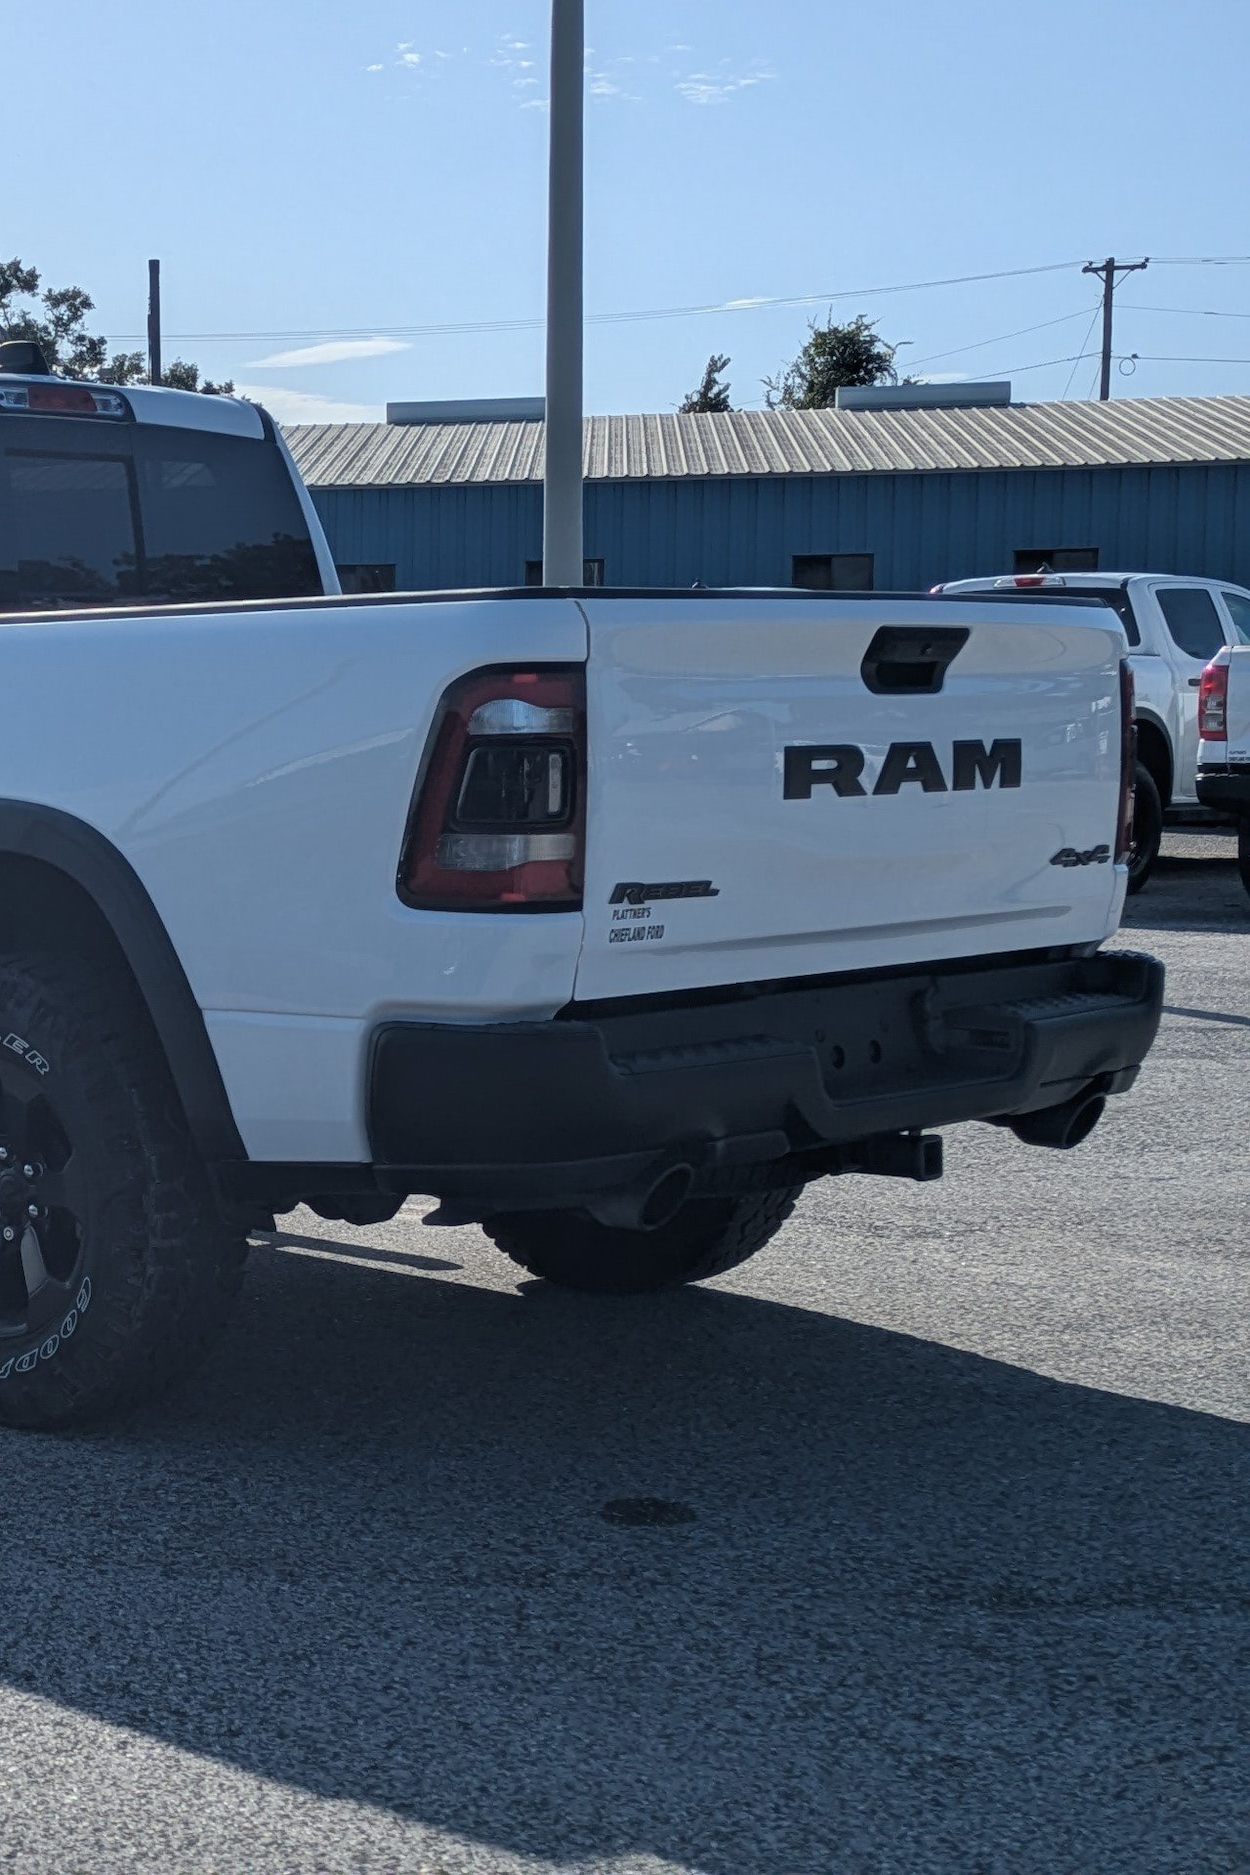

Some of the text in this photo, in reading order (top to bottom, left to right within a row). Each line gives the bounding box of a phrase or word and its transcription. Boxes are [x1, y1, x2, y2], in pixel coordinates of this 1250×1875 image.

[783, 738, 1022, 800] RAM
[608, 880, 720, 905] REBEL
[609, 924, 665, 943] CHIEFLAND FORD
